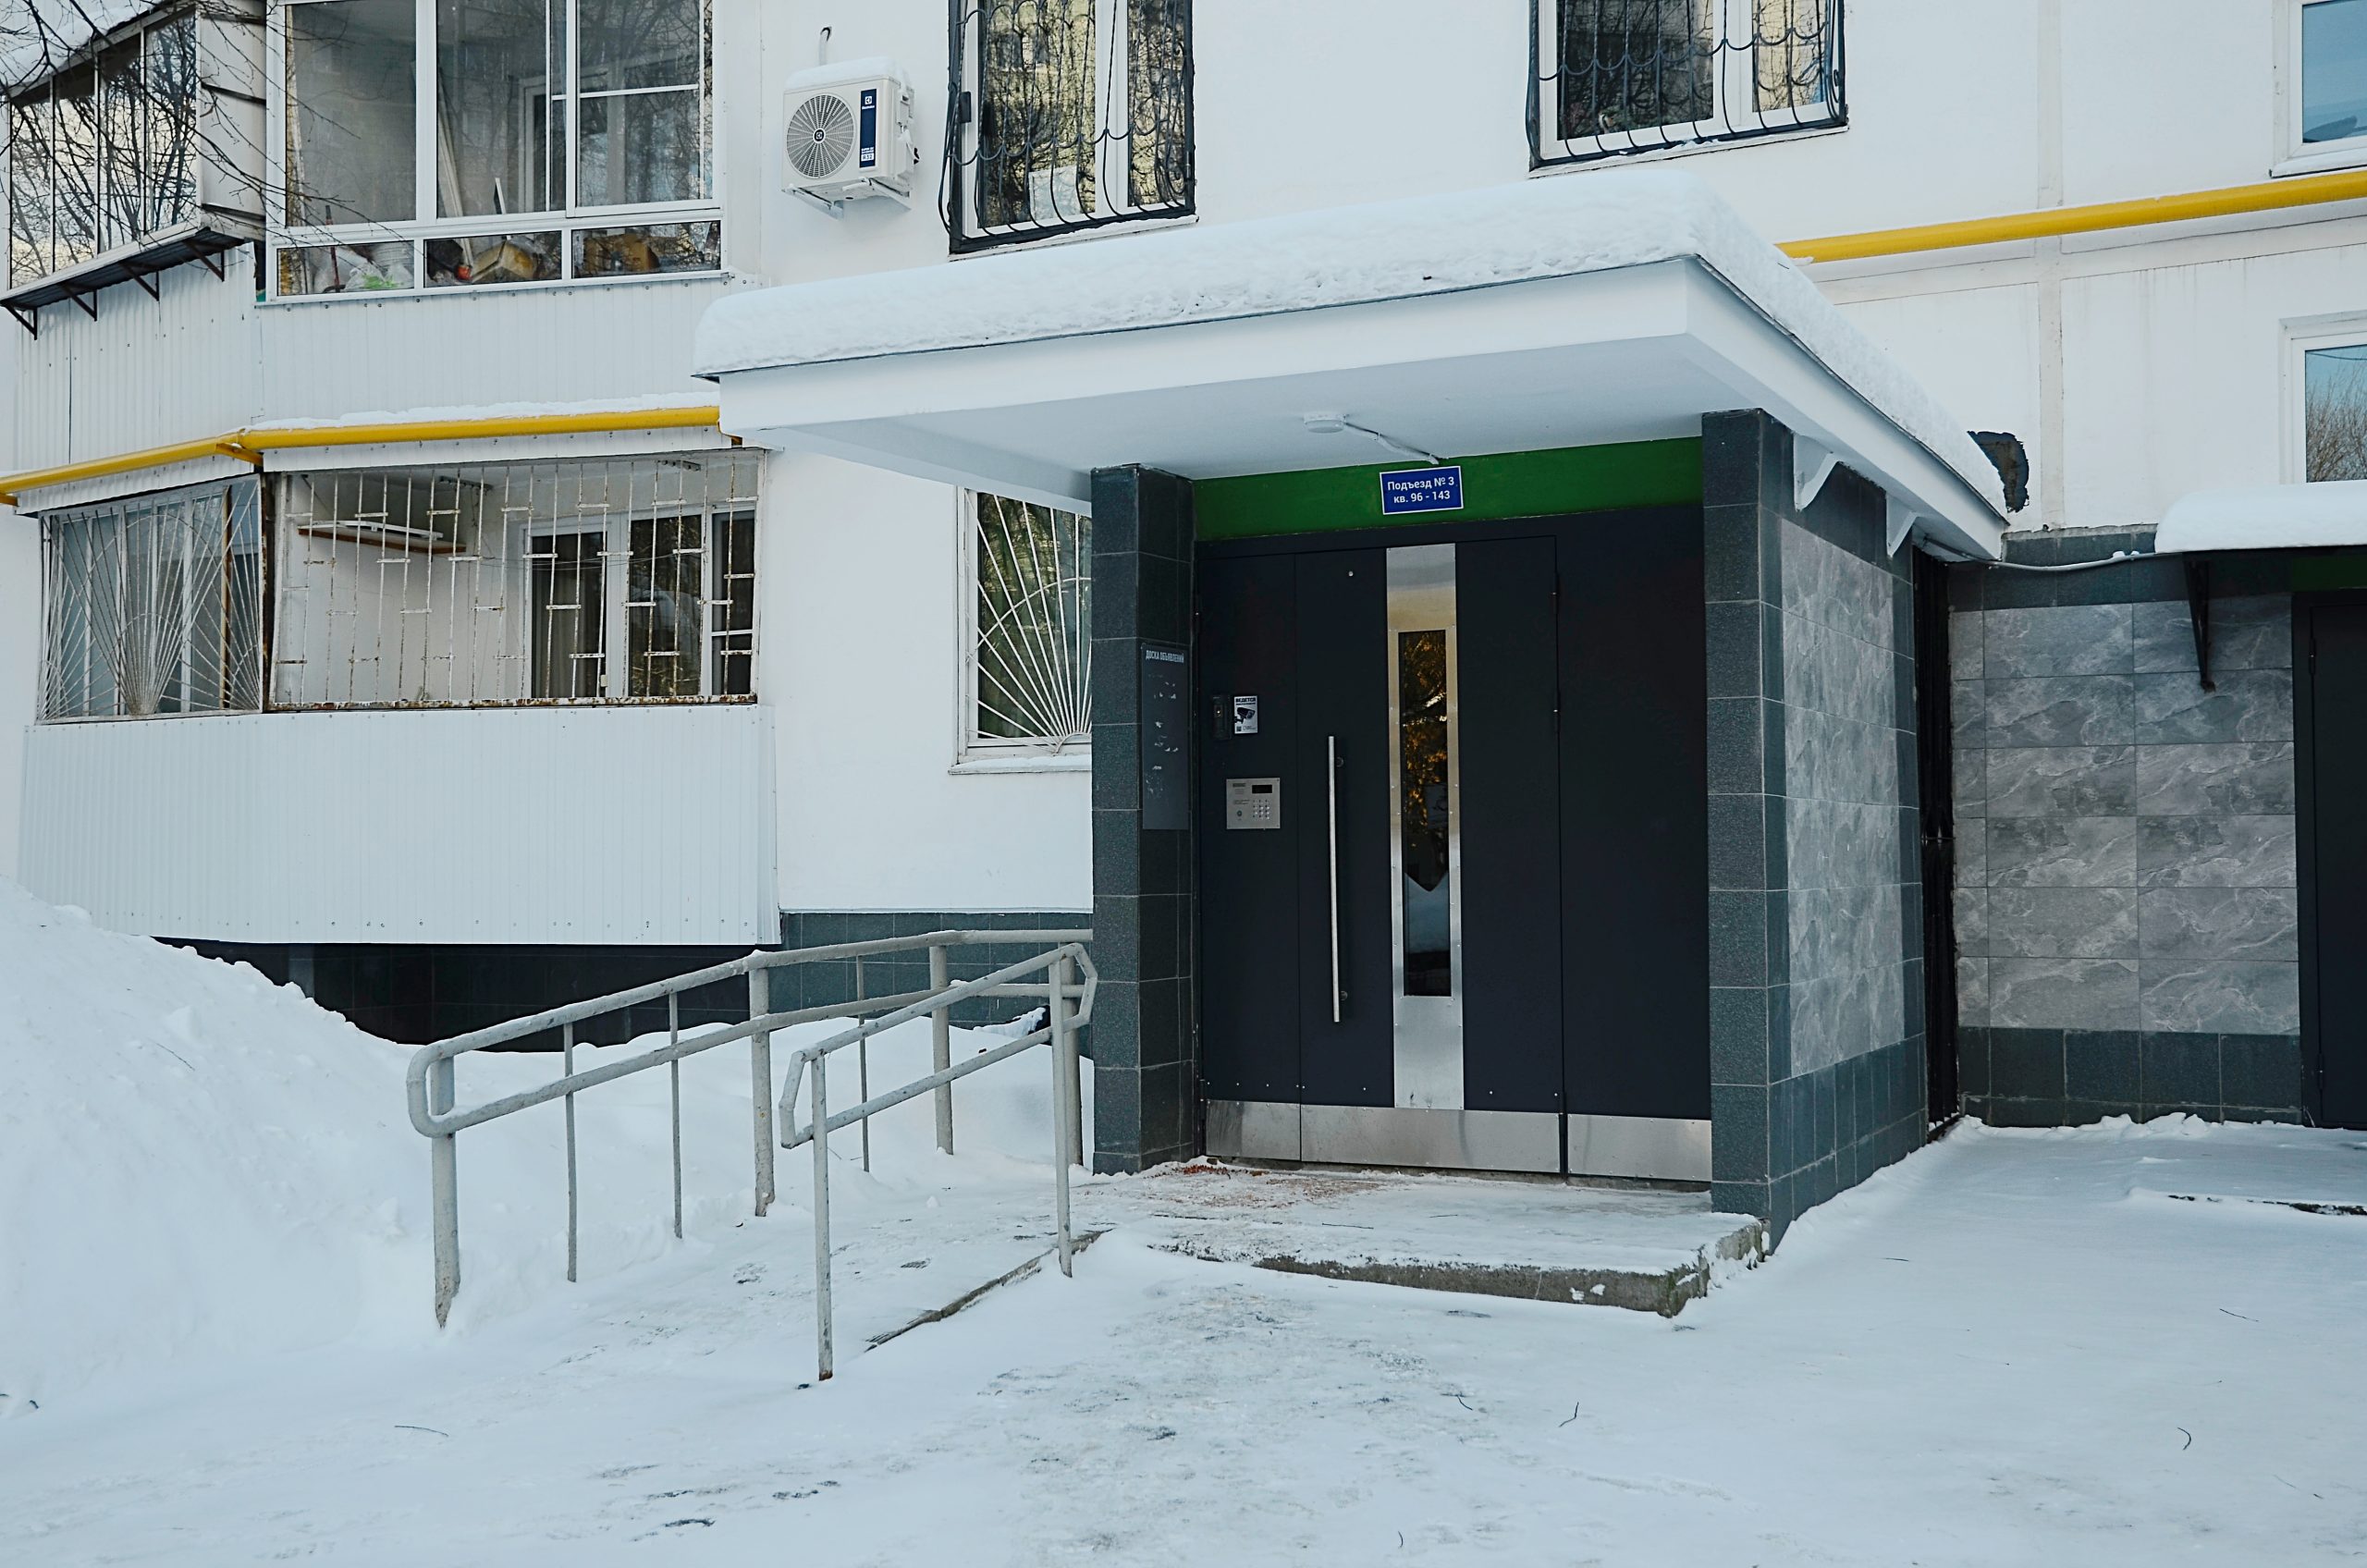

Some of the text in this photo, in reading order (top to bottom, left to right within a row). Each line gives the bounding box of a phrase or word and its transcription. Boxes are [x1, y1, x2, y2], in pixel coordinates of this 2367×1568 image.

[1387, 480, 1432, 491] Подъезд
[1448, 476, 1454, 486] 3
[1393, 496, 1409, 504] кв.
[1410, 492, 1423, 502] 96
[1432, 490, 1450, 500] 143
